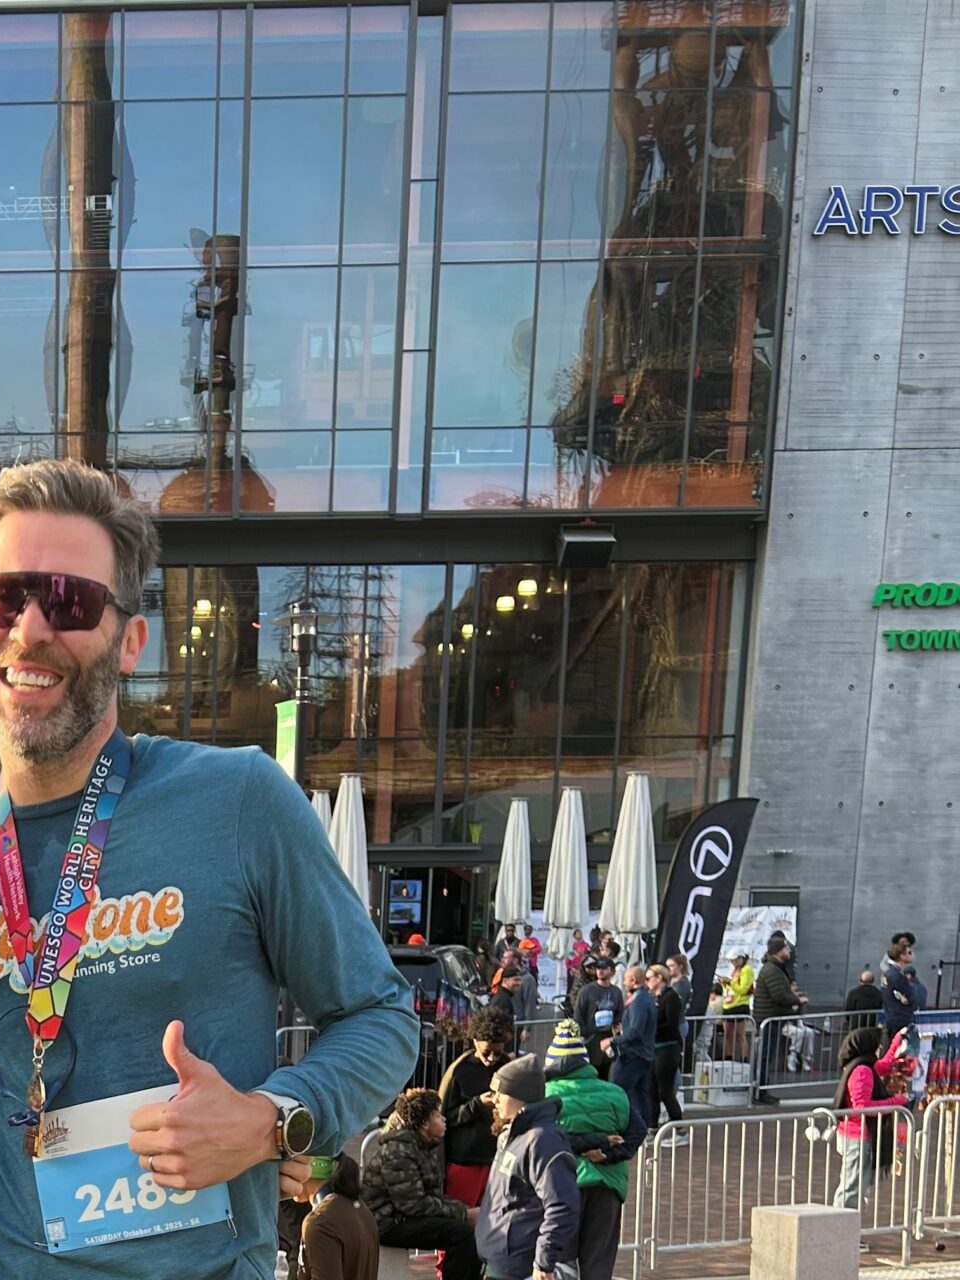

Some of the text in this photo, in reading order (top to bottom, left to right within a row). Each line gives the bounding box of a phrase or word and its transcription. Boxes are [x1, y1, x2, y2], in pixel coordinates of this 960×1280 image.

[39, 754, 113, 984] UNESCO WORLD HERITAGE
[79, 850, 99, 890] CITY
[119, 951, 161, 968] Store
[84, 1232, 122, 1245] SATURDAY
[123, 1227, 151, 1238] October
[164, 1220, 182, 1231] 2025
[190, 1217, 201, 1226] 5K
